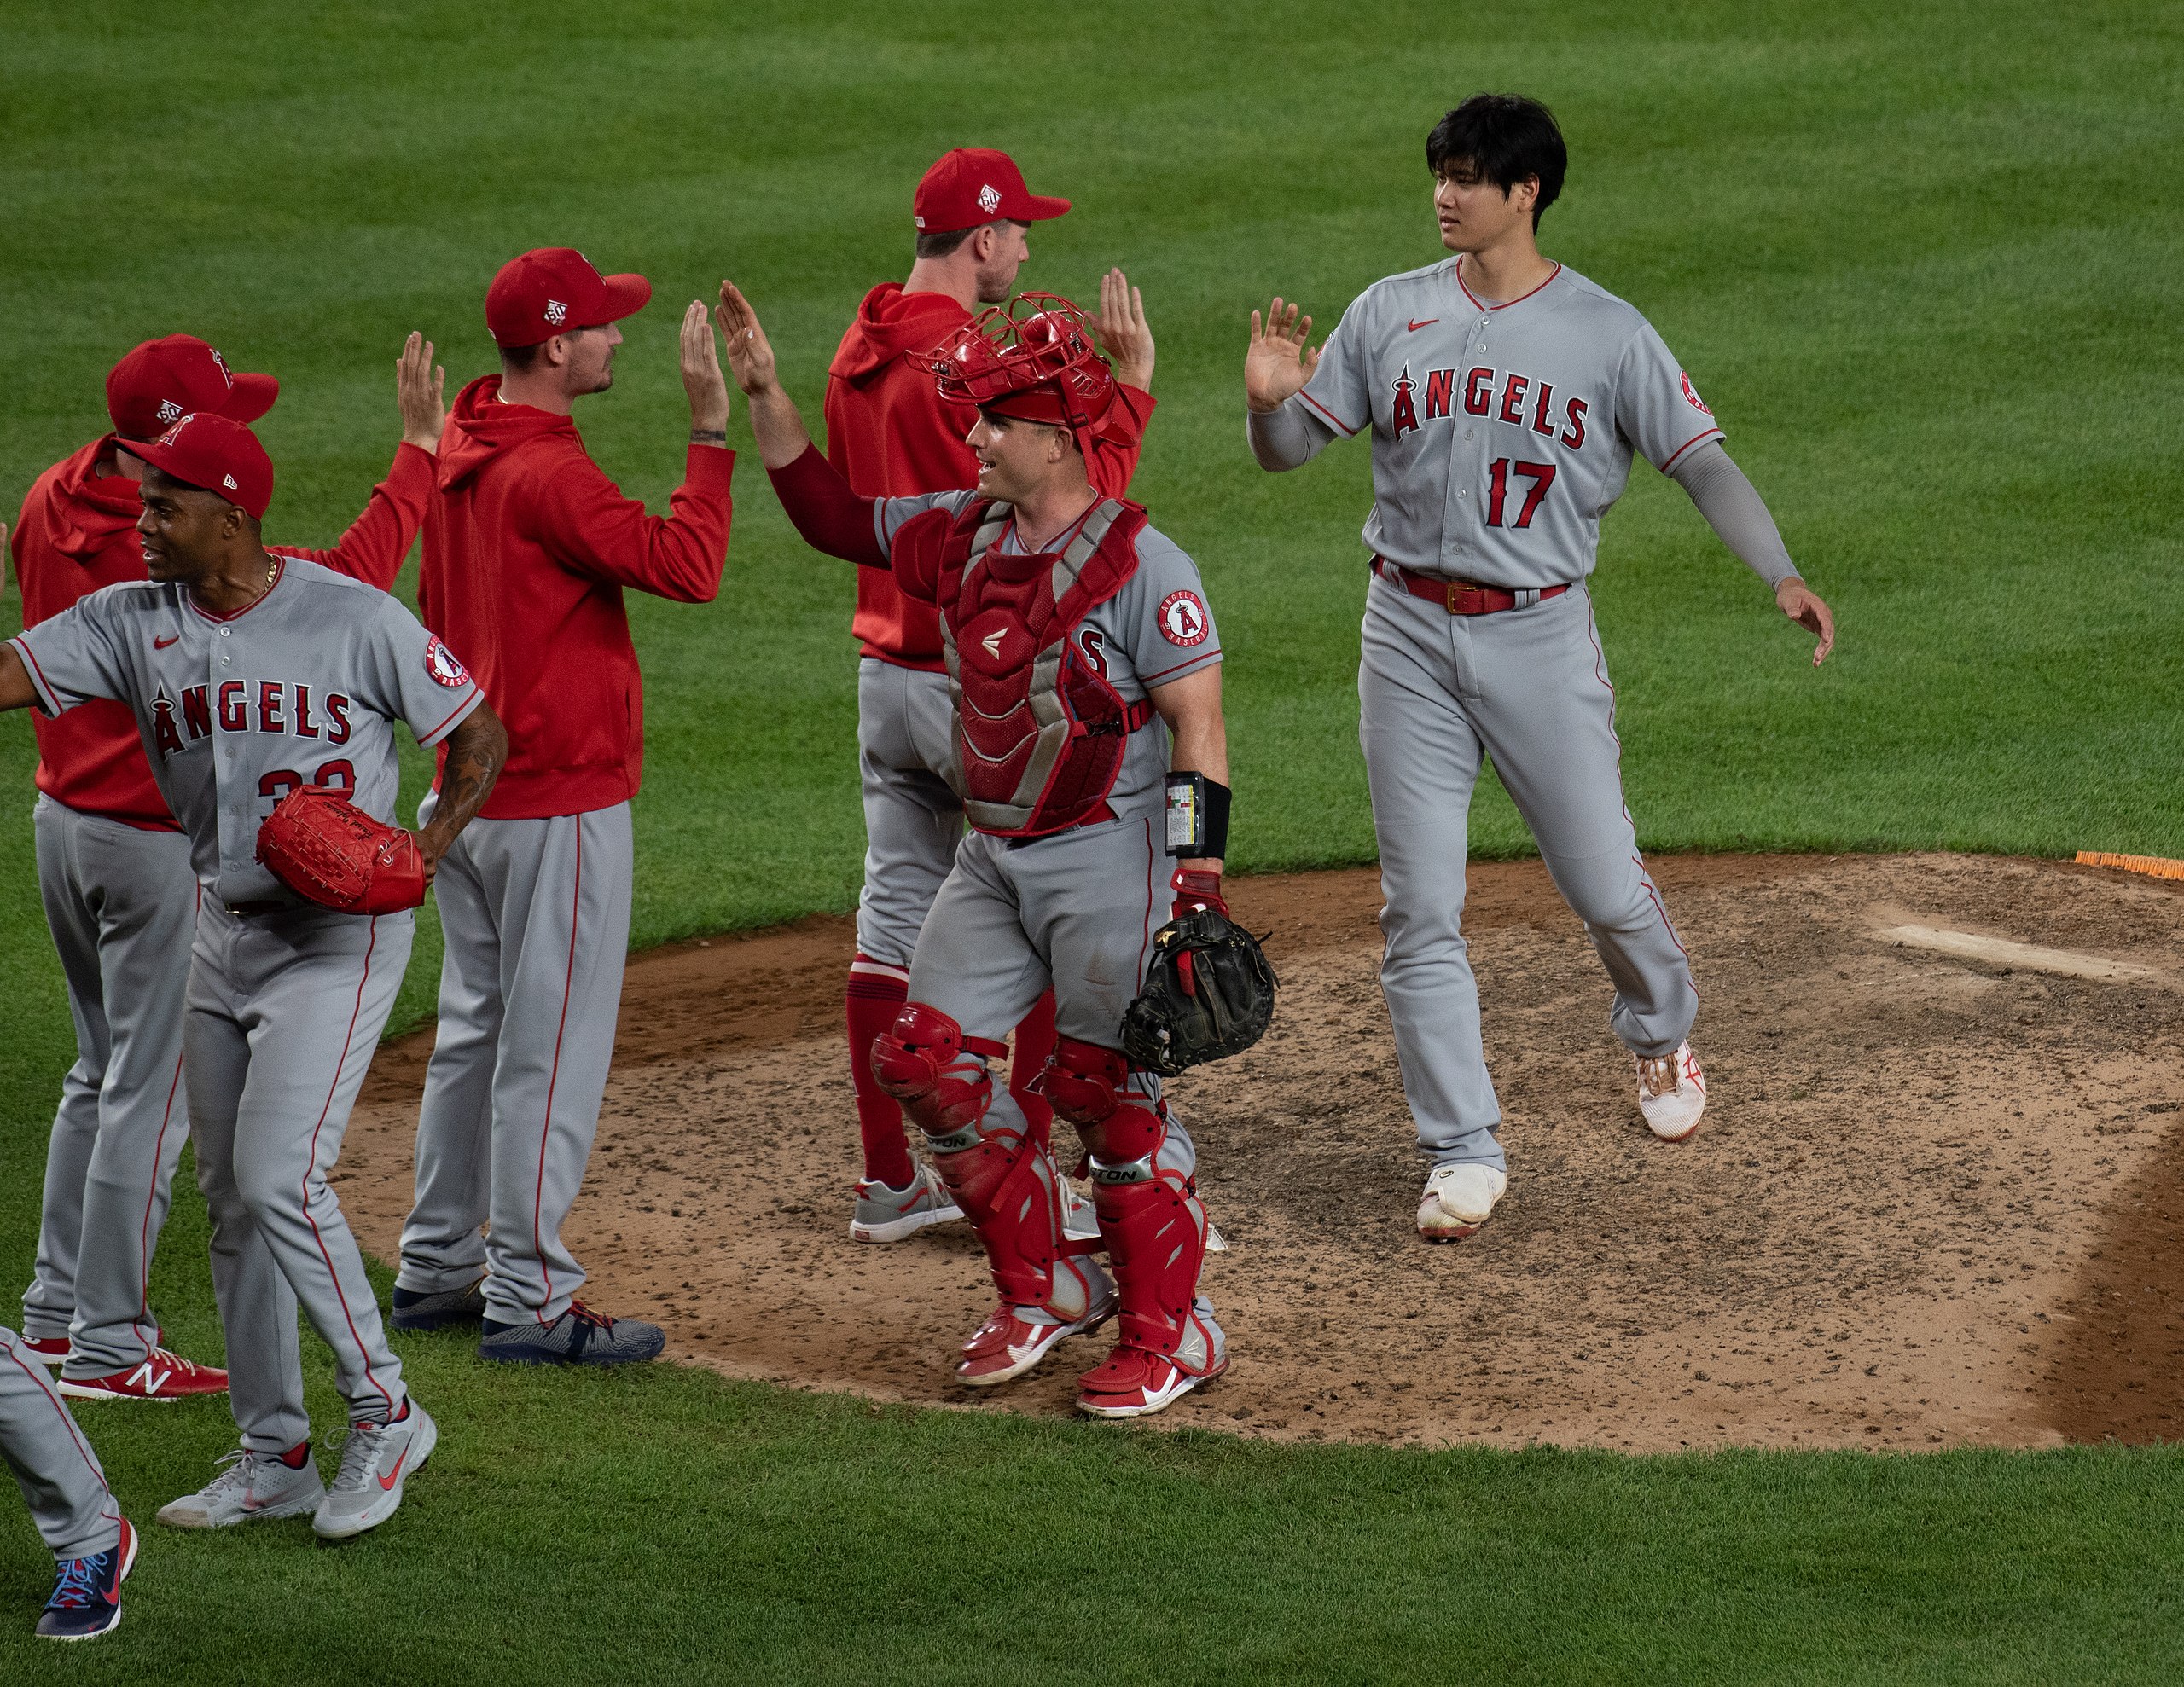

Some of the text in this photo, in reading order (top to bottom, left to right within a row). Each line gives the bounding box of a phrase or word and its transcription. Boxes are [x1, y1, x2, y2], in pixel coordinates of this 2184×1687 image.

[1391, 362, 1589, 451] ANGELS
[1485, 457, 1557, 529] 17
[1161, 591, 1194, 612] ANGELS
[1169, 622, 1208, 646] BASEBALL
[149, 679, 352, 762] ANGELS
[125, 1363, 171, 1394] N
